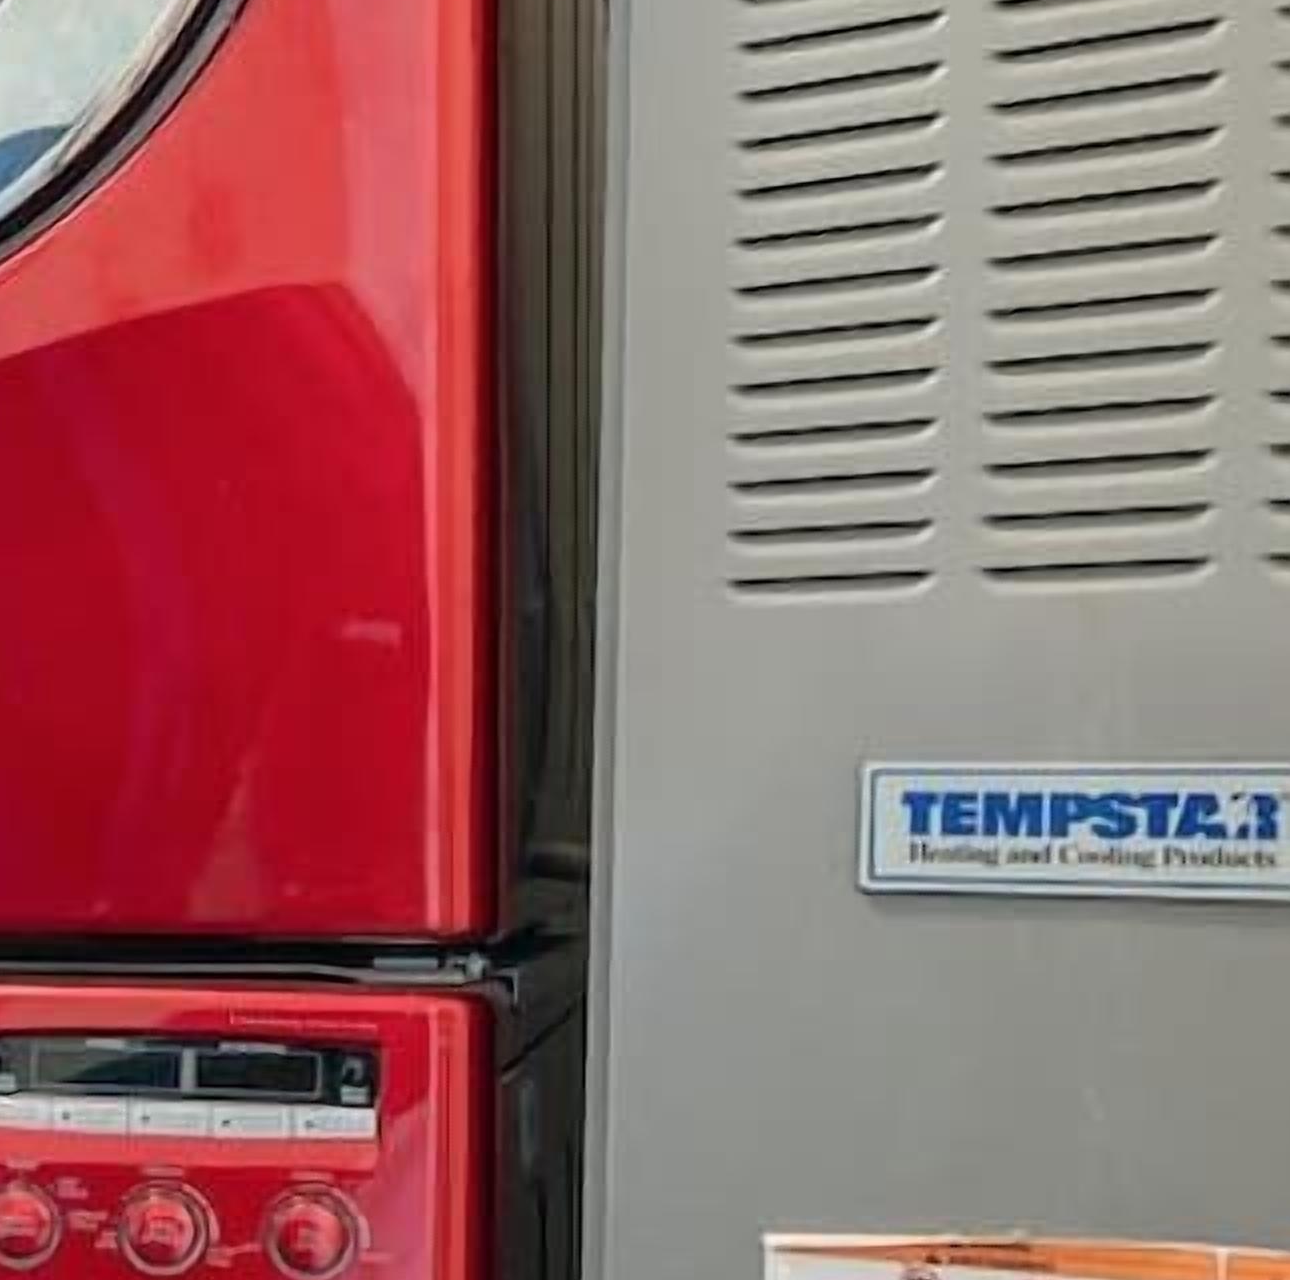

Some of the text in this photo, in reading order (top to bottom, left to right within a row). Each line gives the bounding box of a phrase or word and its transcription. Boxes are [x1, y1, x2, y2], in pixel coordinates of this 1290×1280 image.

[901, 791, 1279, 839] TEMPSTAR
[1007, 844, 1051, 864] and
[1162, 845, 1277, 867] Products
